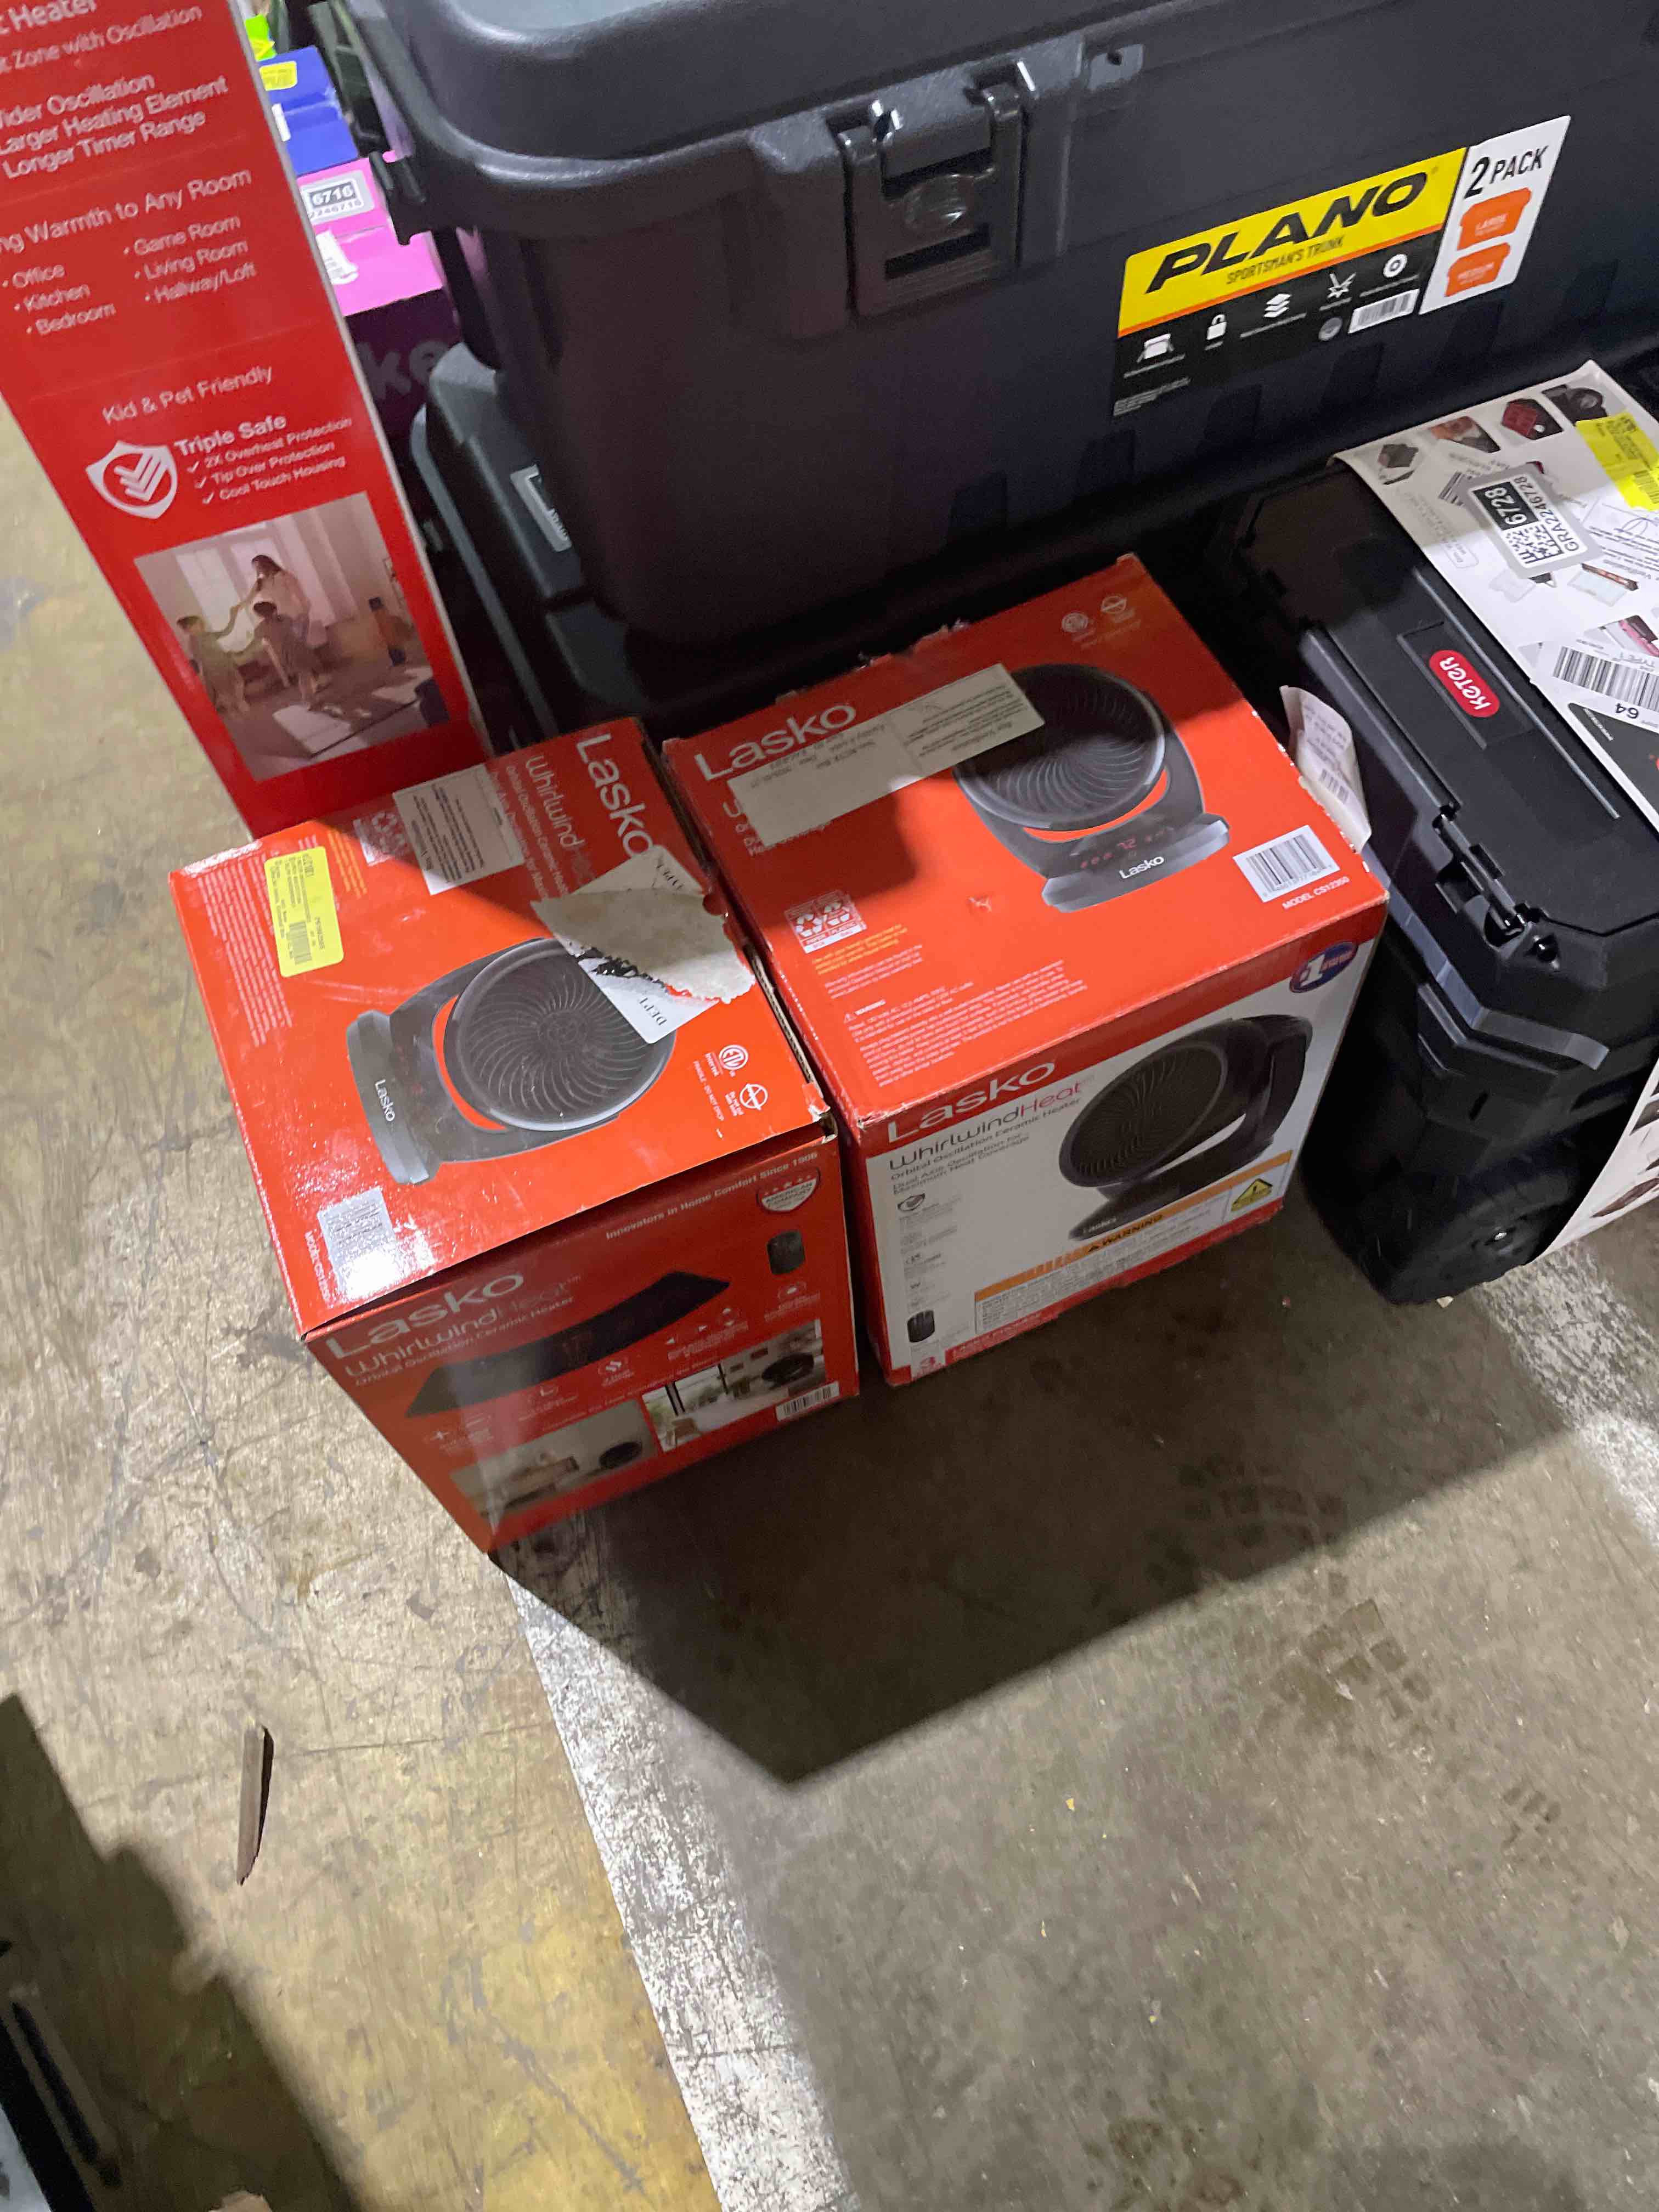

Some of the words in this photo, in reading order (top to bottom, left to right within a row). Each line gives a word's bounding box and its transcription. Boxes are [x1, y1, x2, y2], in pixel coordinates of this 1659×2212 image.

[8, 0, 96, 30] Heater
[12, 44, 60, 70] Zone
[62, 29, 105, 54] with
[106, 5, 202, 44] Oscillation
[47, 74, 155, 115] Oscillation
[62, 102, 144, 137] Heating
[145, 75, 228, 115] Element
[2, 146, 75, 178] Longer
[78, 131, 137, 157] Timer
[139, 110, 206, 143] Range
[1463, 156, 1491, 199] 2
[1488, 144, 1550, 185] PACK
[25, 206, 112, 244] Warmth
[115, 201, 139, 220] to
[144, 189, 183, 213] Any
[187, 169, 252, 201] Room
[134, 231, 187, 256] Game
[188, 215, 241, 241] Room
[1145, 171, 1429, 295] PLANO
[12, 264, 65, 289] Office
[143, 255, 196, 280] Living
[196, 240, 249, 266] Room
[23, 284, 91, 313] Kitchen
[35, 303, 117, 336] Bedroom
[102, 400, 138, 425] Kid
[140, 396, 158, 415] &
[159, 385, 194, 408] Pet
[196, 365, 273, 400] Friendly
[173, 428, 236, 458] Triple
[237, 415, 287, 441] Safe
[224, 435, 285, 464] Overheat
[286, 416, 353, 445] Protection
[211, 467, 234, 487] Tip
[235, 458, 267, 477] Over
[268, 441, 336, 470] Protection
[219, 484, 251, 501] Cool
[251, 469, 291, 493] Touch
[292, 456, 347, 480] Housing
[1484, 487, 1527, 526] 6728
[1514, 476, 1579, 552] GRA2246728
[693, 704, 857, 782] Lasko
[577, 732, 658, 856] Lasko
[1118, 855, 1165, 879] Lasko
[375, 1079, 395, 1122] Lasko
[887, 1062, 1056, 1146] Lasko
[891, 1159, 931, 1180] Orbital
[933, 1134, 994, 1163] Oscillation
[995, 1112, 1041, 1137] Ceramic
[1042, 1097, 1082, 1119] Heater
[605, 1211, 665, 1241] Innovators
[679, 1192, 713, 1214] Home
[714, 1174, 758, 1198] Comfort
[759, 1163, 789, 1182] Since
[325, 1273, 524, 1361] Lasko
